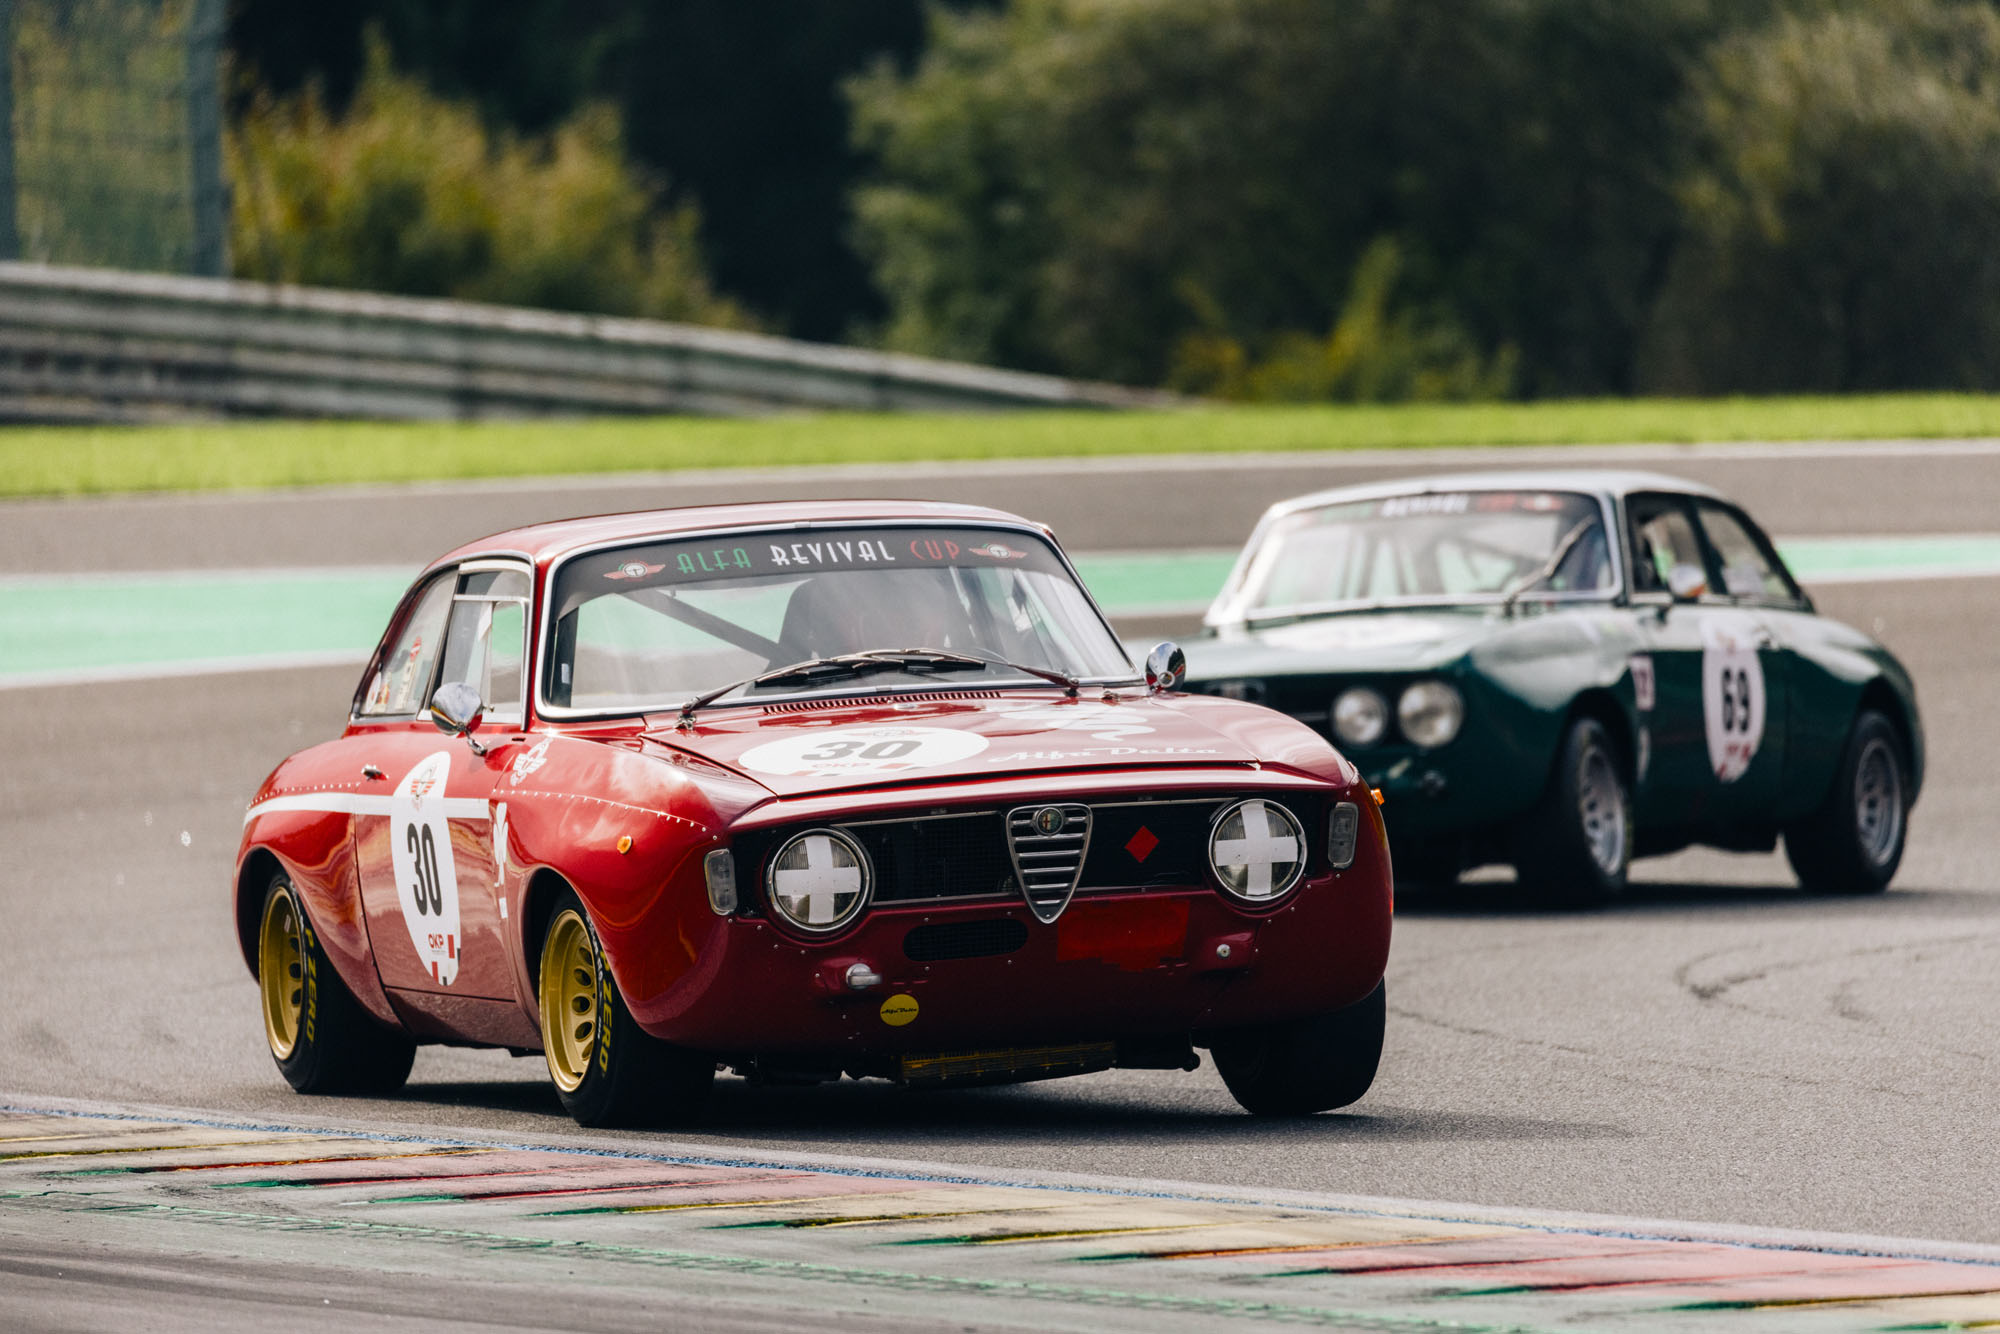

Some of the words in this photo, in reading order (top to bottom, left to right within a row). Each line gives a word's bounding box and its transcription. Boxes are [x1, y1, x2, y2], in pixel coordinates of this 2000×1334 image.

[677, 548, 752, 574] ALFA
[770, 540, 895, 566] REVIVAL
[910, 539, 960, 560] CUP
[1722, 668, 1750, 733] 69
[801, 740, 923, 760] 30
[988, 750, 1090, 763] Alfa
[1083, 747, 1224, 755] Delta
[407, 823, 442, 917] 30
[305, 928, 314, 948] P
[306, 956, 317, 1043] ZERO
[600, 979, 612, 1073] ZERO
